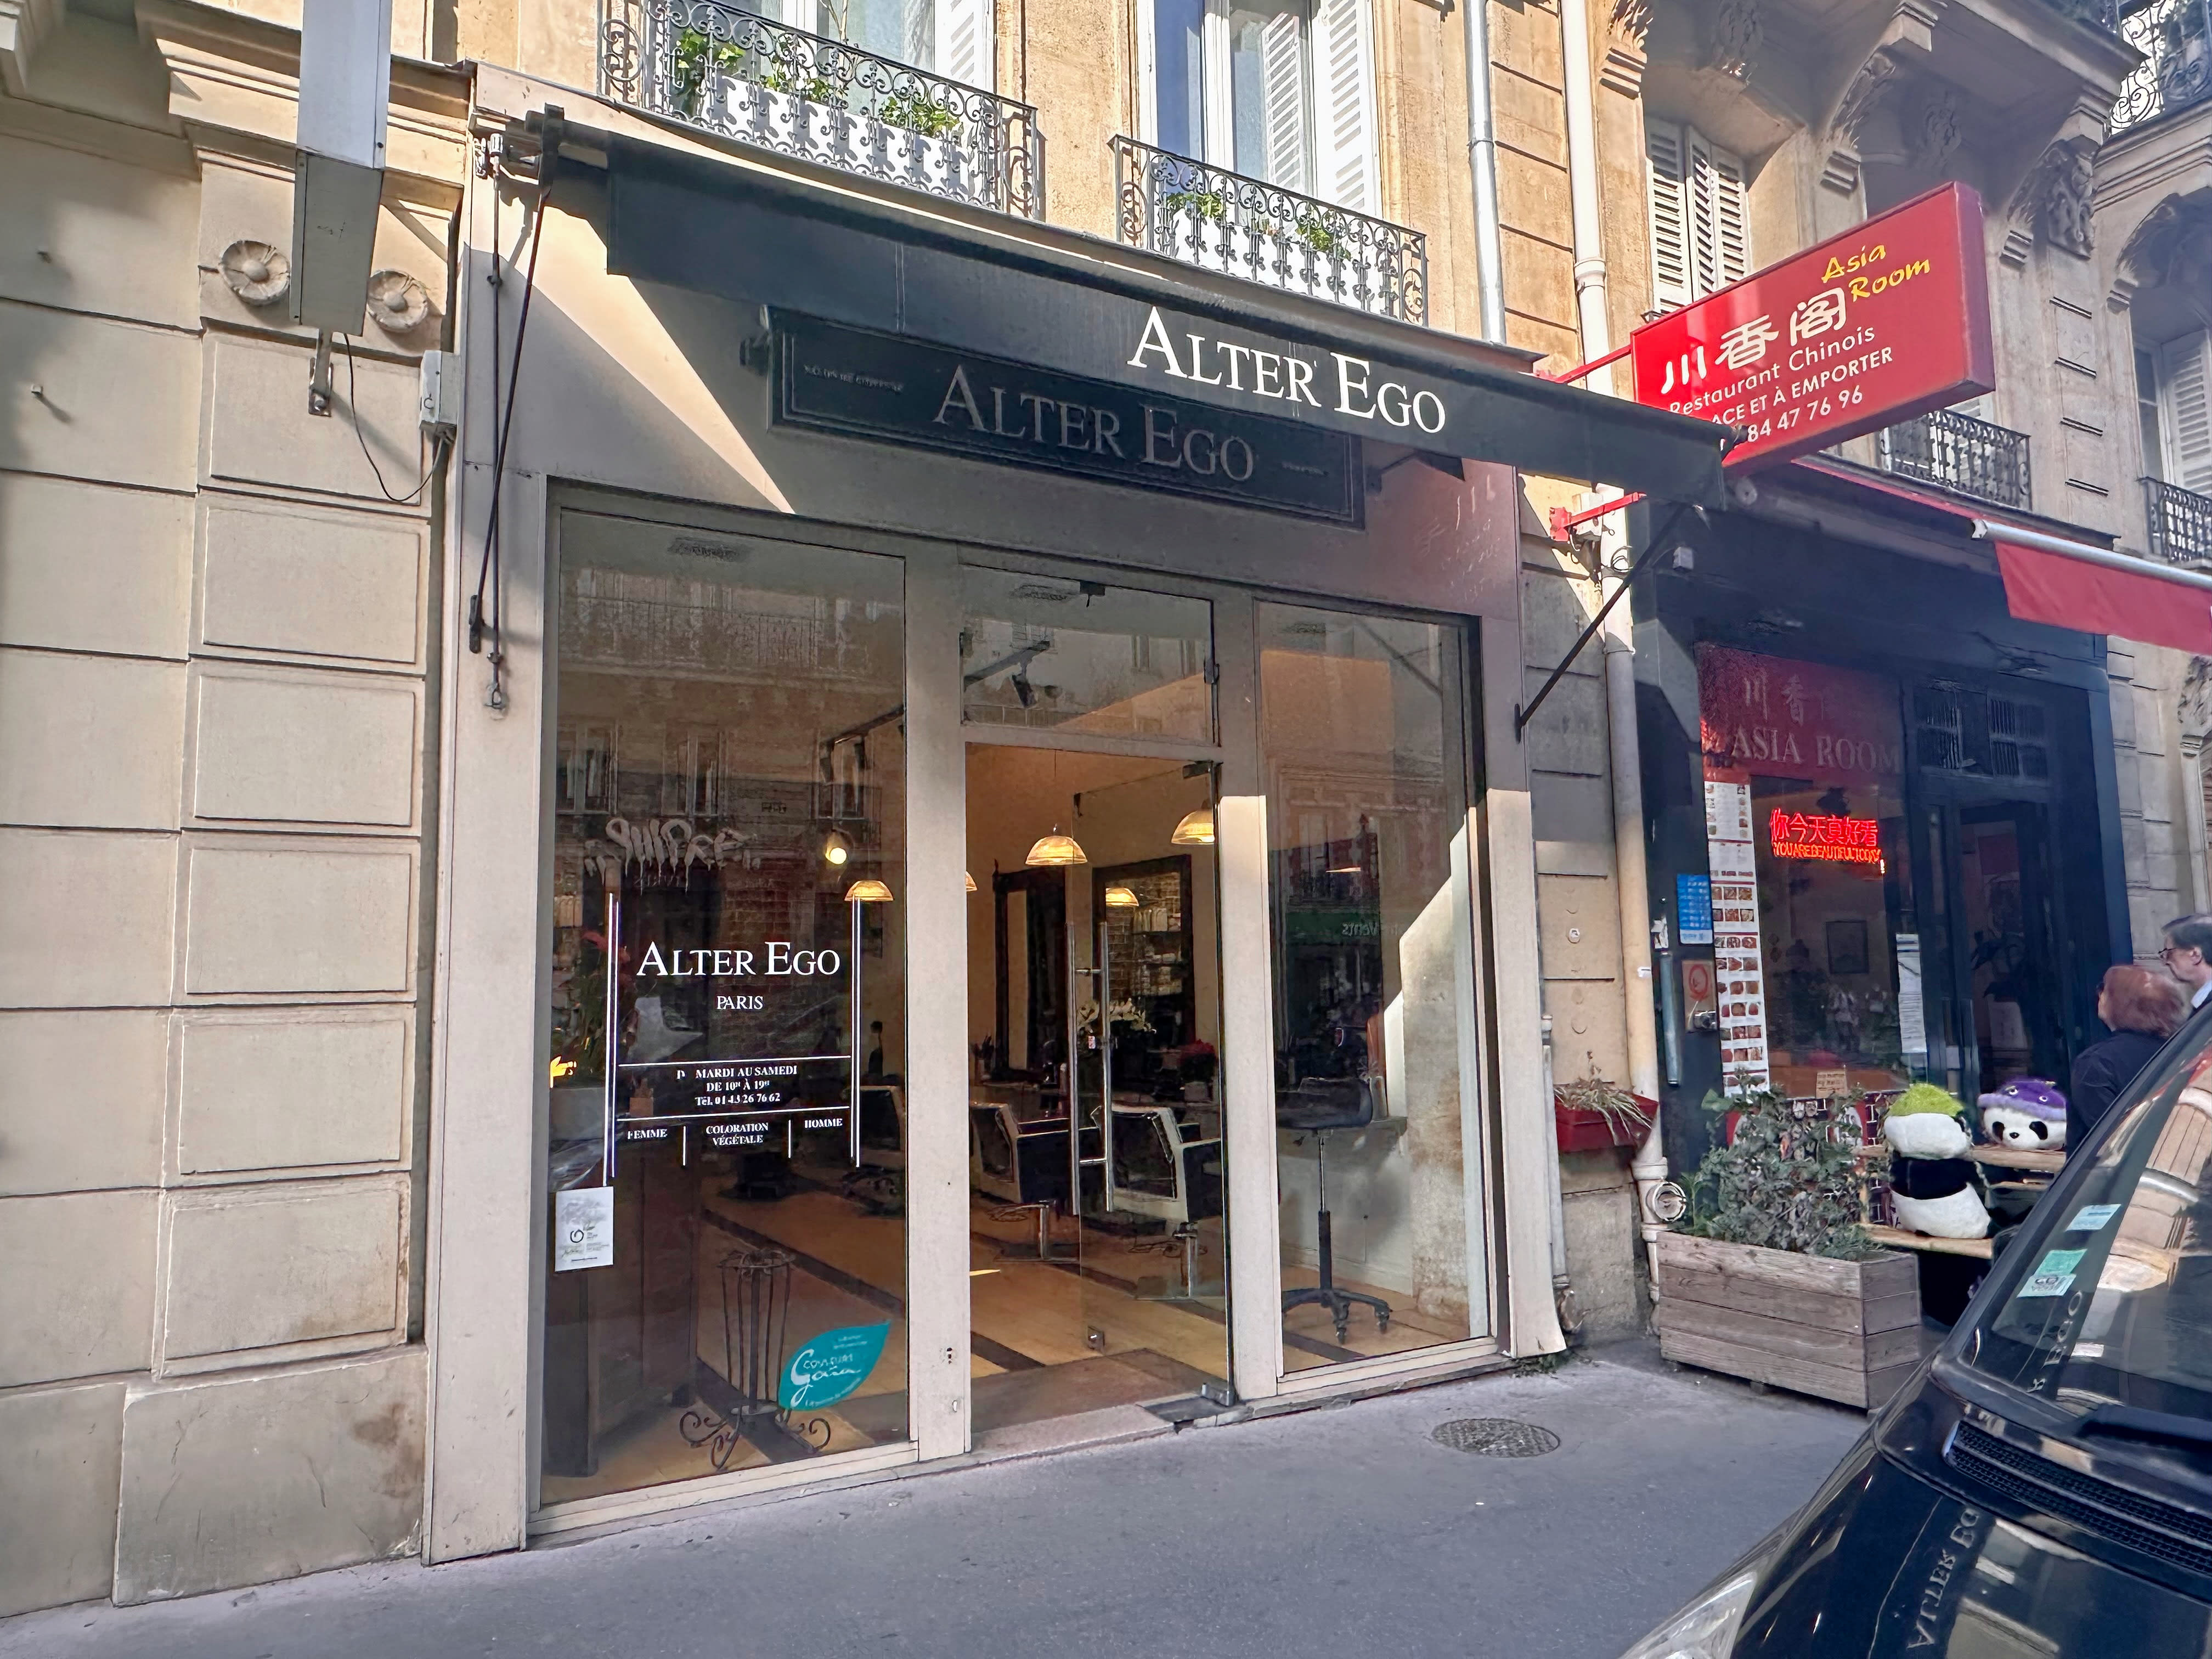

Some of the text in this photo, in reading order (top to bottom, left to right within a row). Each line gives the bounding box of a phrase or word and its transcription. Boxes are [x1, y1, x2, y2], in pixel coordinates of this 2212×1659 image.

[1821, 244, 1886, 283] Asia
[1848, 260, 1931, 302] Room
[1661, 287, 1847, 394] 川香阁
[1127, 307, 1446, 433] ALTER EGO
[1670, 326, 1875, 415] Restaurant Chinois
[1750, 395, 1767, 415] ET
[1773, 386, 1786, 407] À
[1791, 347, 1893, 398] EMPORTER
[932, 365, 1255, 482] ALTER EGO
[1747, 385, 1863, 442] 84 47 76 96
[1731, 724, 1900, 773] ASIA ROOM
[636, 941, 840, 976] ALTER EGO
[716, 996, 763, 1009] PARIS
[696, 1068, 734, 1079] MARDI
[738, 1067, 753, 1077] AU
[754, 1065, 797, 1076] SAMEDI
[707, 1082, 722, 1092] DE
[743, 1078, 751, 1090] À
[742, 1094, 754, 1103] 26
[757, 1093, 767, 1103] 76
[769, 1093, 780, 1102] 62
[628, 1128, 668, 1139] FEMME
[706, 1122, 768, 1134] COLORATION
[713, 1135, 764, 1146] VÉGÉTALE
[804, 1118, 843, 1128] HOMME
